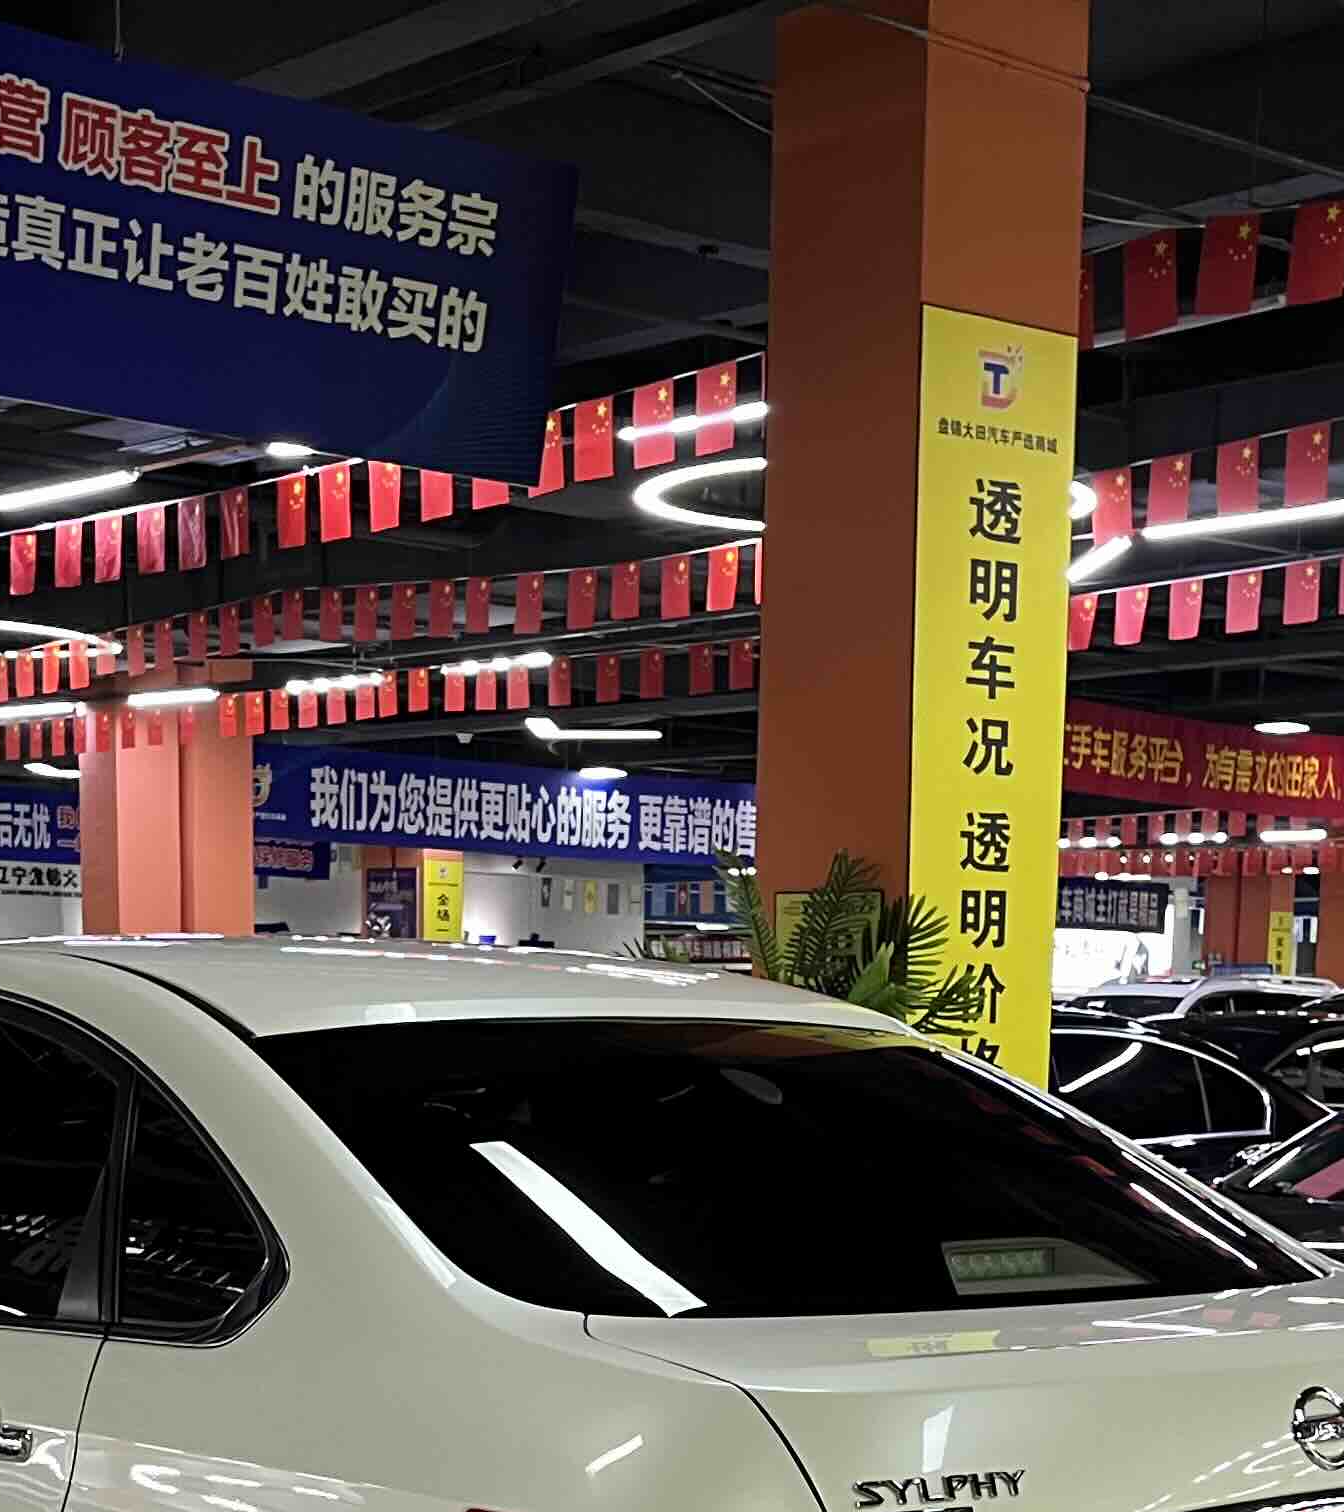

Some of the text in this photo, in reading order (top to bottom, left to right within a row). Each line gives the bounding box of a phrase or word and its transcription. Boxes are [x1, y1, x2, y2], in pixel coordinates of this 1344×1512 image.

[58, 92, 280, 216] 顾客至上
[293, 154, 498, 257] 的服务宗
[962, 478, 1023, 776] 透明车况
[310, 765, 756, 858] 我们为您提供更贴心的服务 更靠谱的售
[853, 1469, 1026, 1508] SYLPHY
